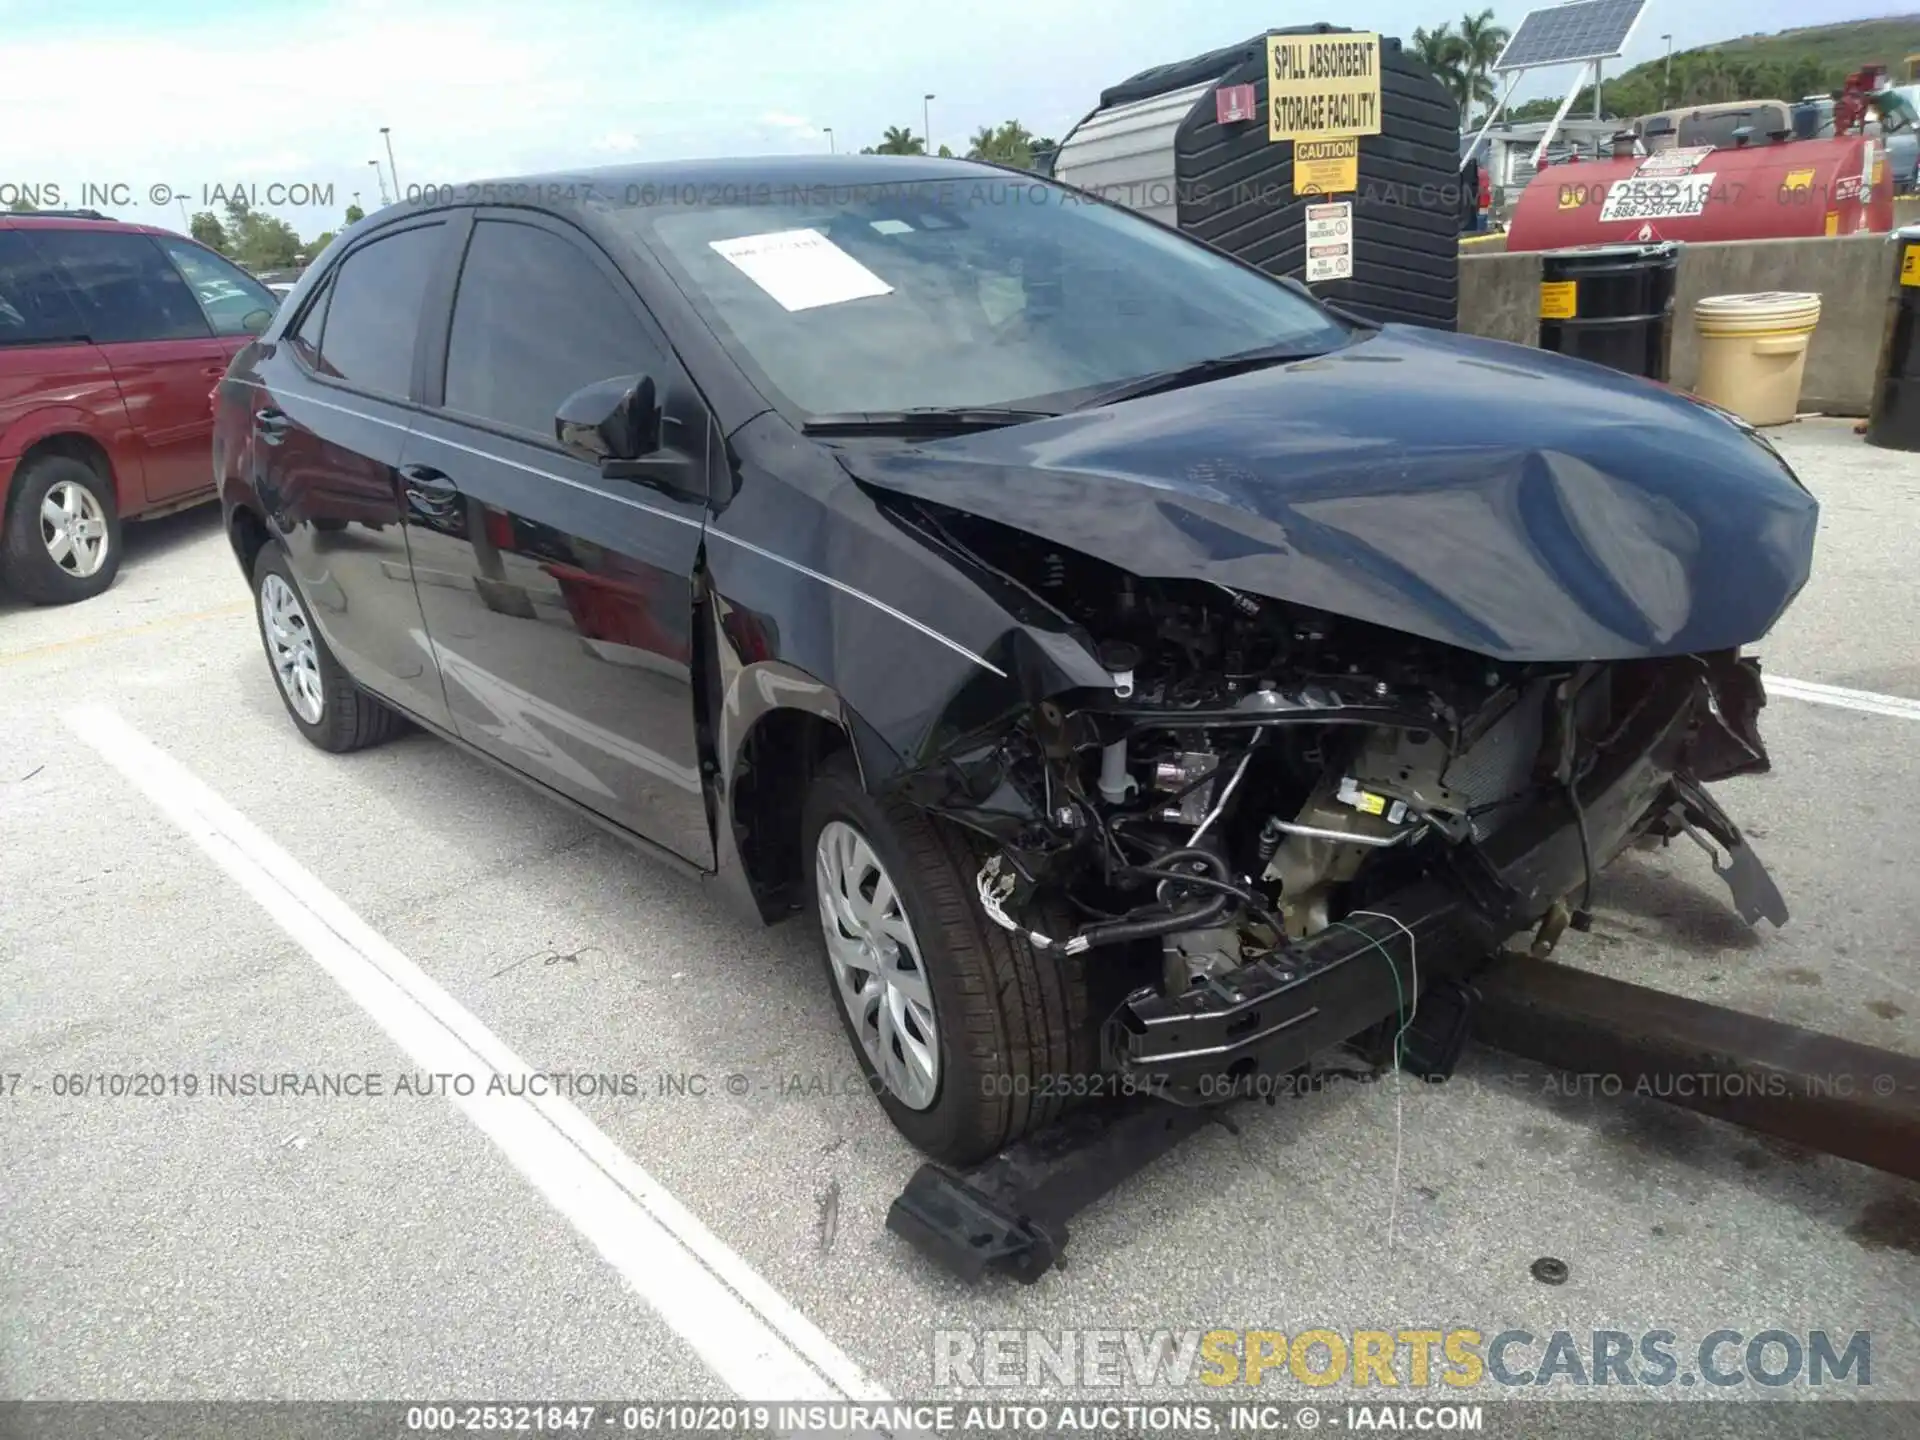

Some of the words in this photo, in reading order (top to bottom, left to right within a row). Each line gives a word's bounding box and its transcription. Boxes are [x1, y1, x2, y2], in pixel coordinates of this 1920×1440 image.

[1274, 44, 1306, 80] SPILL
[1308, 42, 1374, 78] ABSORBENT
[1274, 95, 1325, 132] STORAGE
[1327, 91, 1376, 128] FACILITY
[1298, 142, 1354, 159] CAUTION
